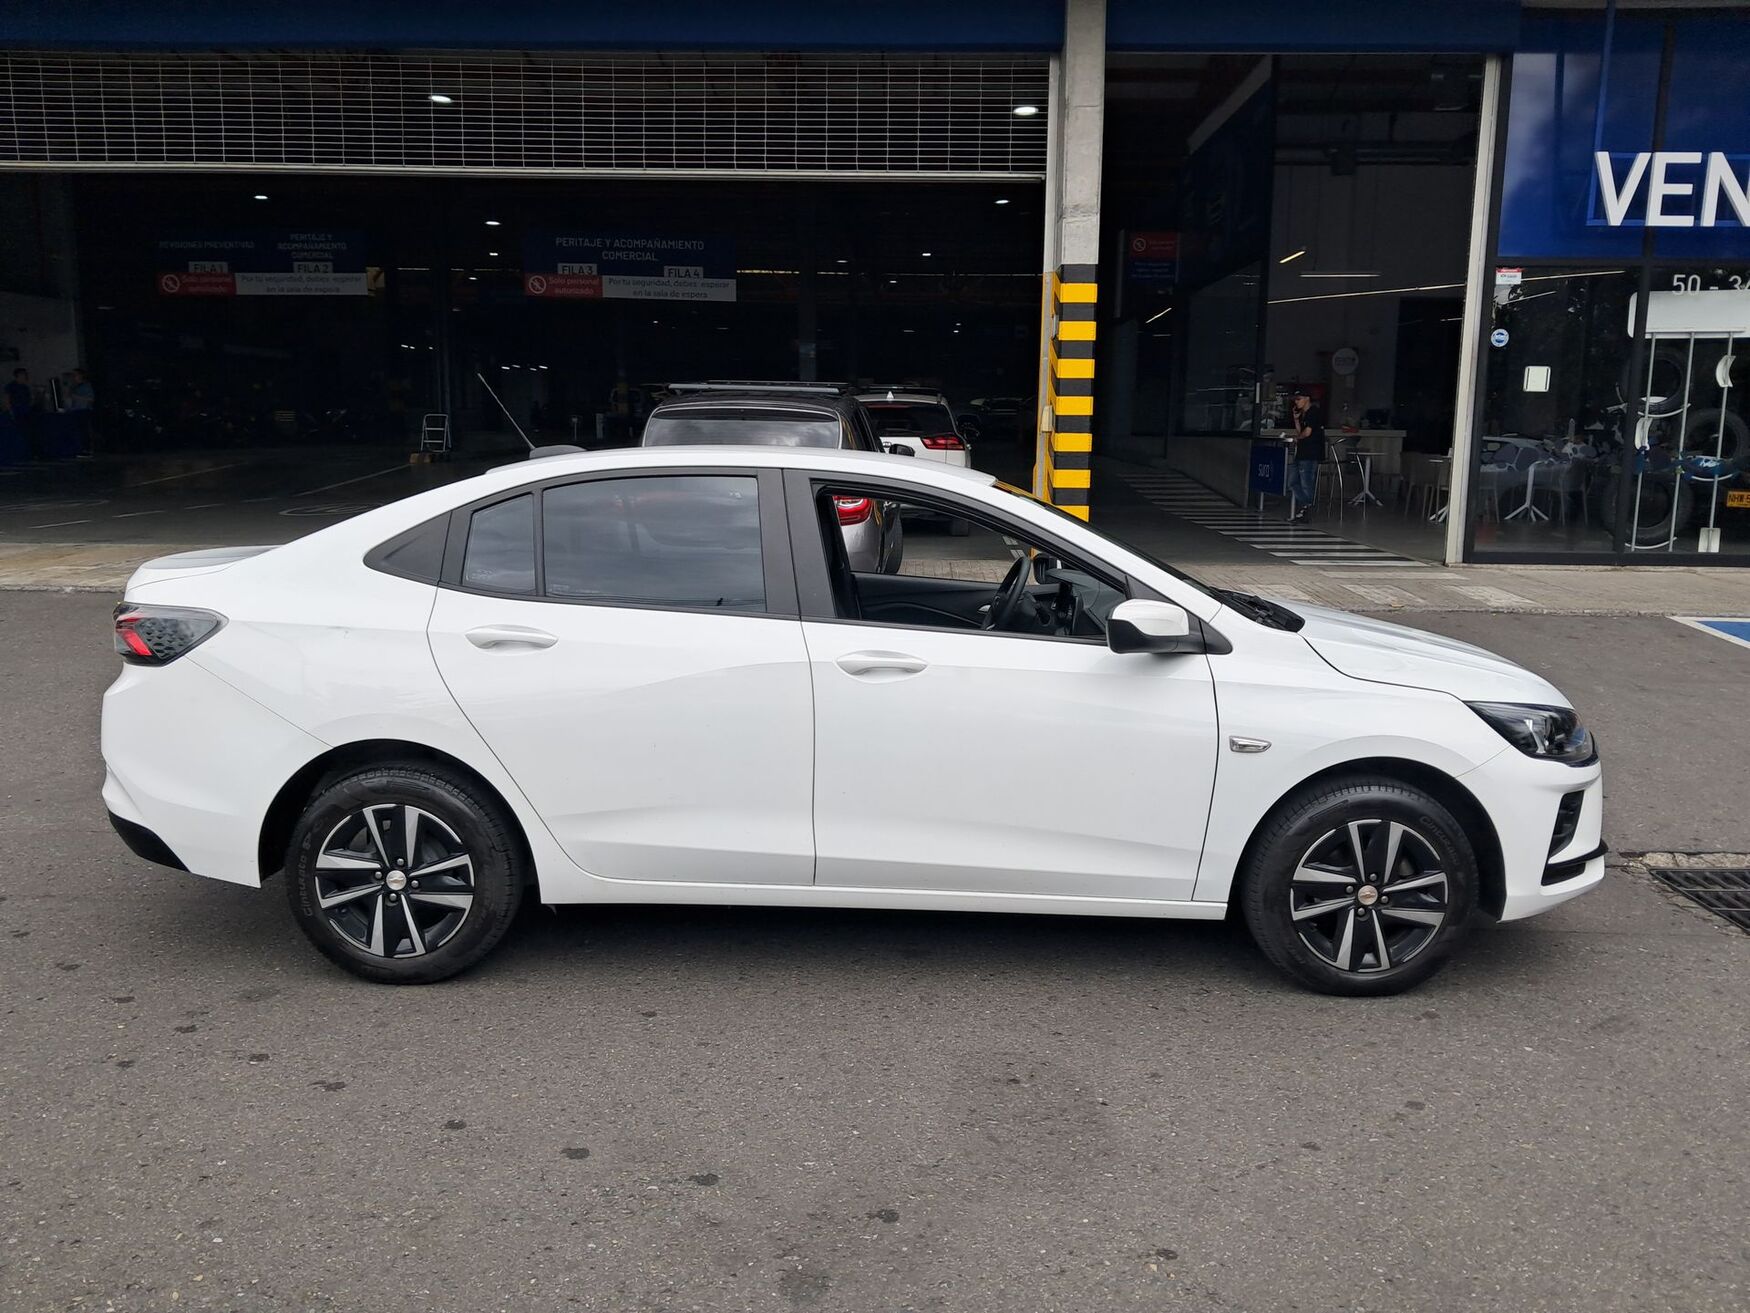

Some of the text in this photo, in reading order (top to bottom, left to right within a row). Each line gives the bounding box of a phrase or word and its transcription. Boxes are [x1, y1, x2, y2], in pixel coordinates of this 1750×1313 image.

[1594, 151, 1750, 227] VEN
[555, 238, 704, 250] PERITAJE Y ACOMPAÑAMIENTO
[602, 250, 657, 261] COMERCIAL
[193, 263, 218, 272] FILA
[298, 264, 329, 273] FILA 2
[562, 265, 595, 275] FILA 3
[668, 268, 700, 278] FILA 4
[1672, 274, 1702, 296] 50
